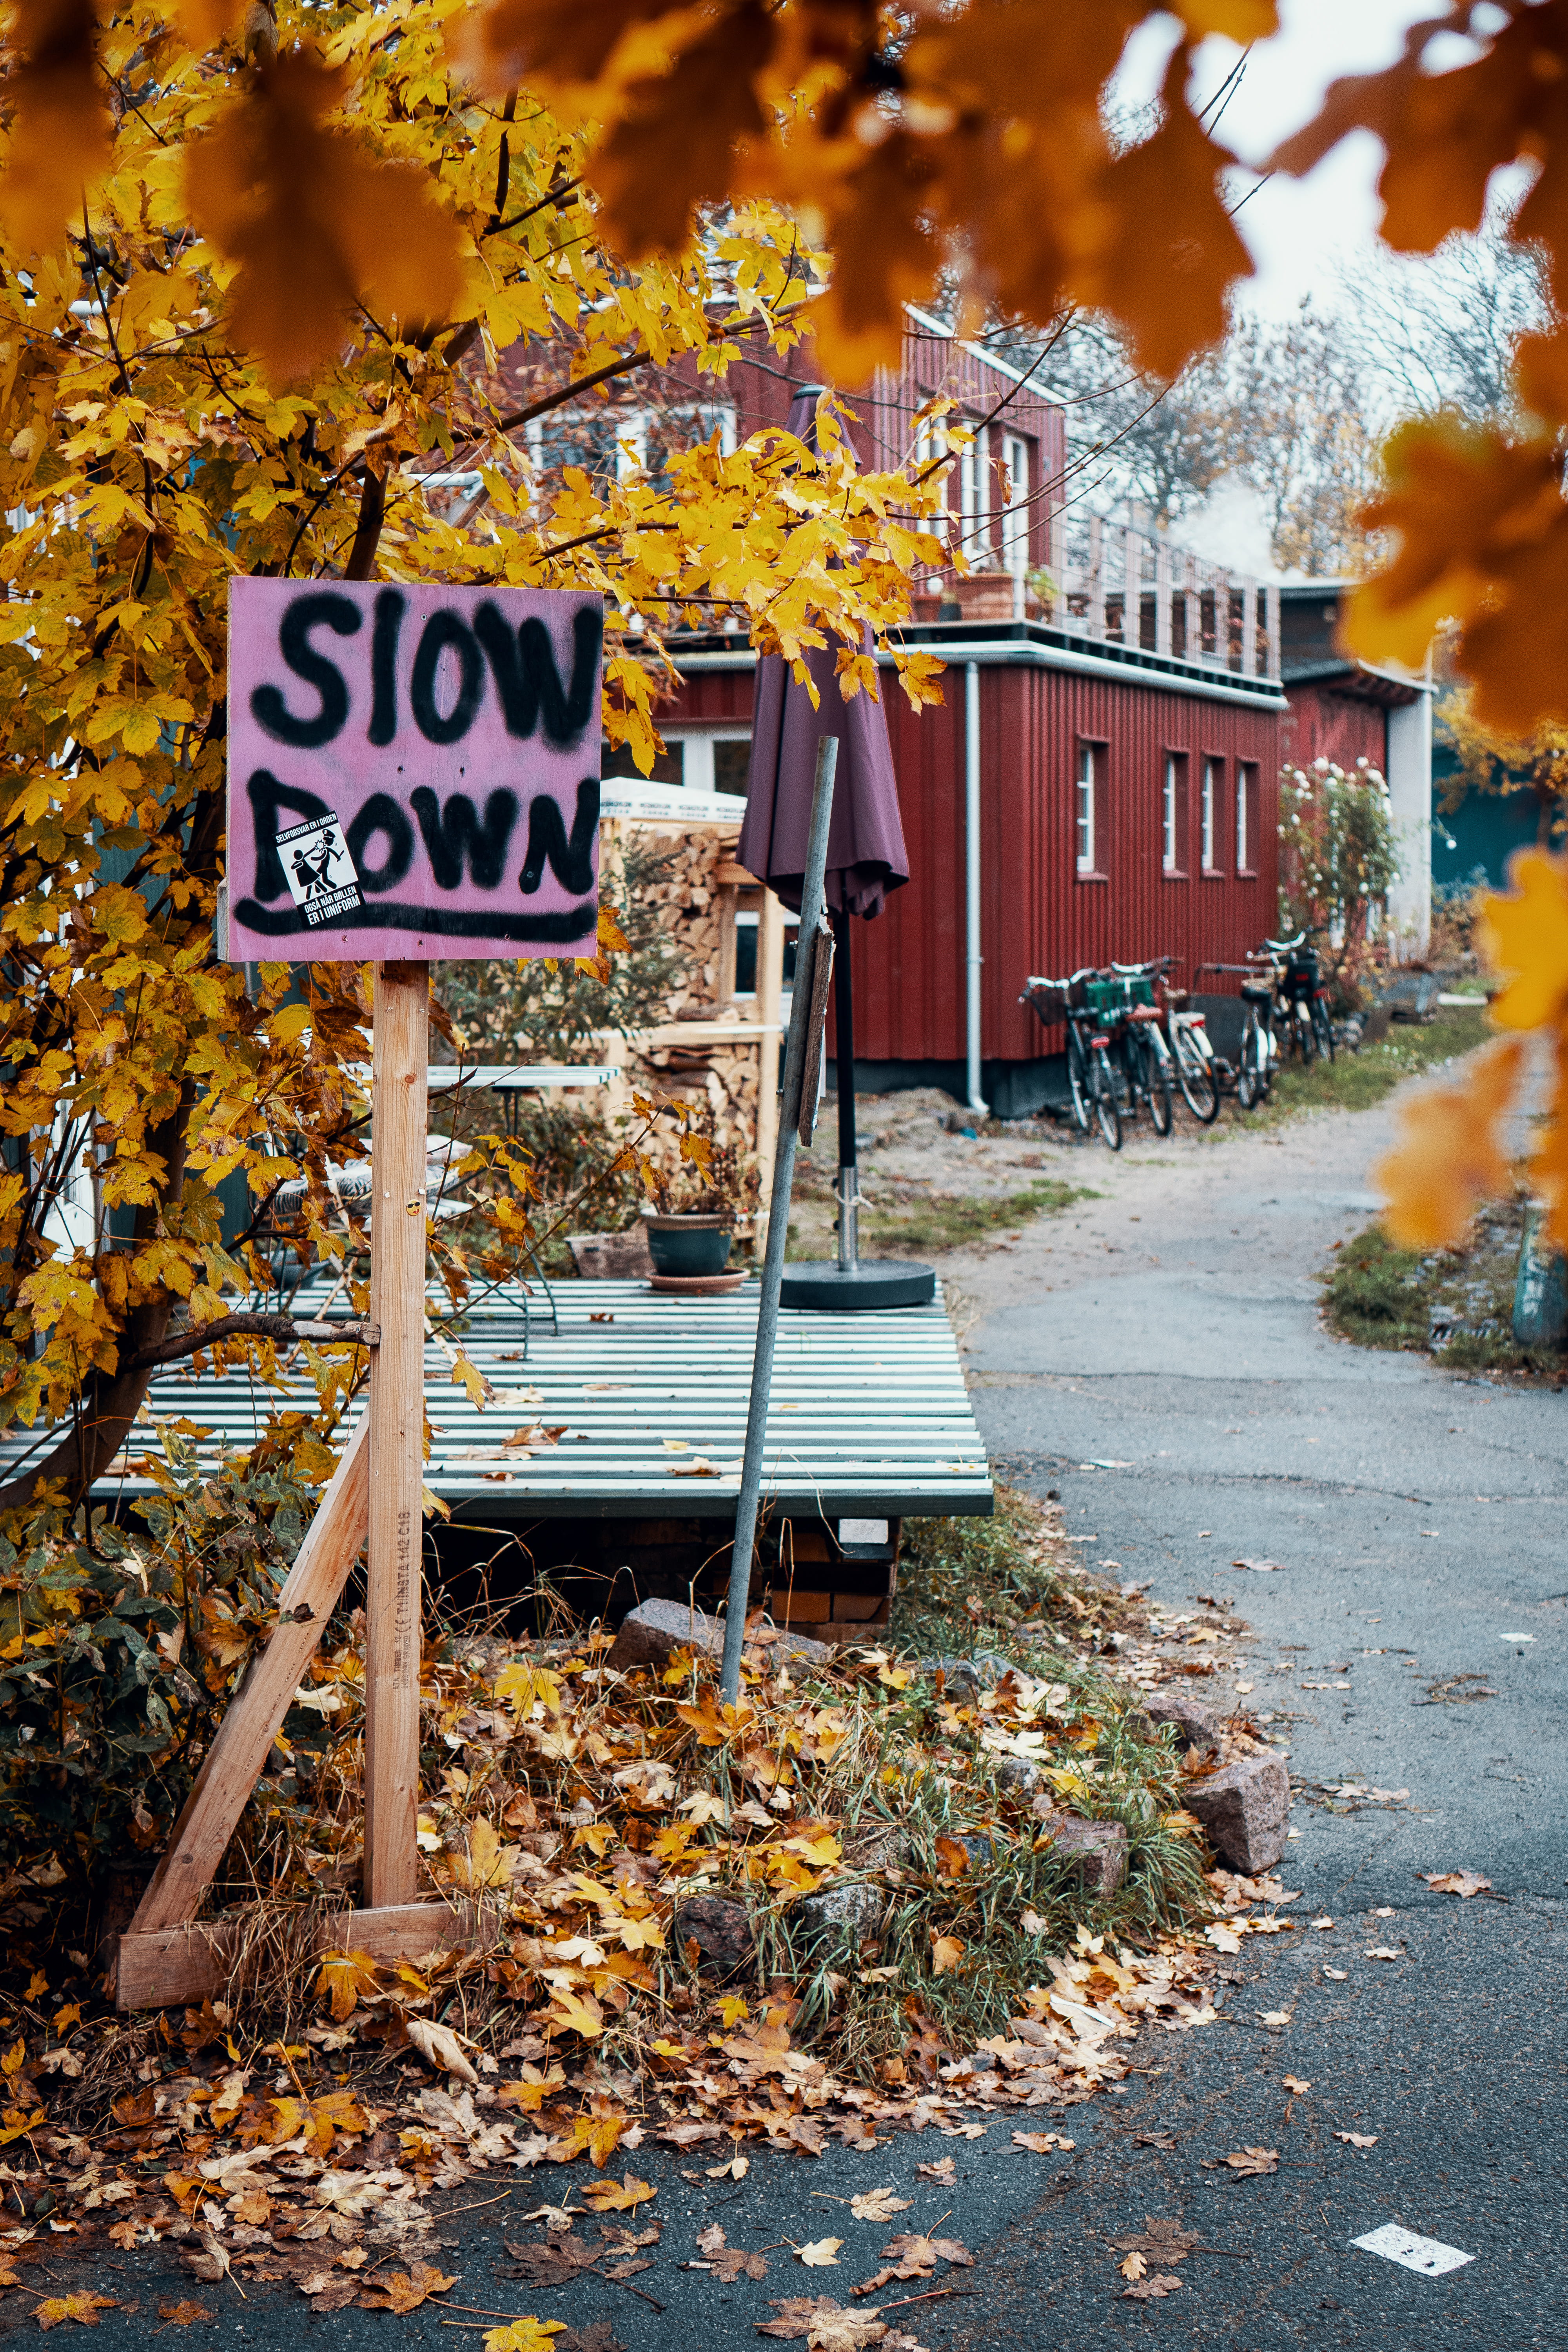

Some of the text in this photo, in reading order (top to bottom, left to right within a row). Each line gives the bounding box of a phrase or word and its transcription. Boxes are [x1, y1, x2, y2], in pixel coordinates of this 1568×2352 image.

[246, 769, 601, 902] DOWN
[276, 824, 310, 843] SELVFORSVAR
[309, 821, 317, 830] ER
[320, 813, 337, 826] ORDEN
[304, 885, 357, 913] OGSÅ NÅR BØLLEN
[307, 895, 361, 925] ER I UNIFORM
[397, 1539, 410, 1560] 142
